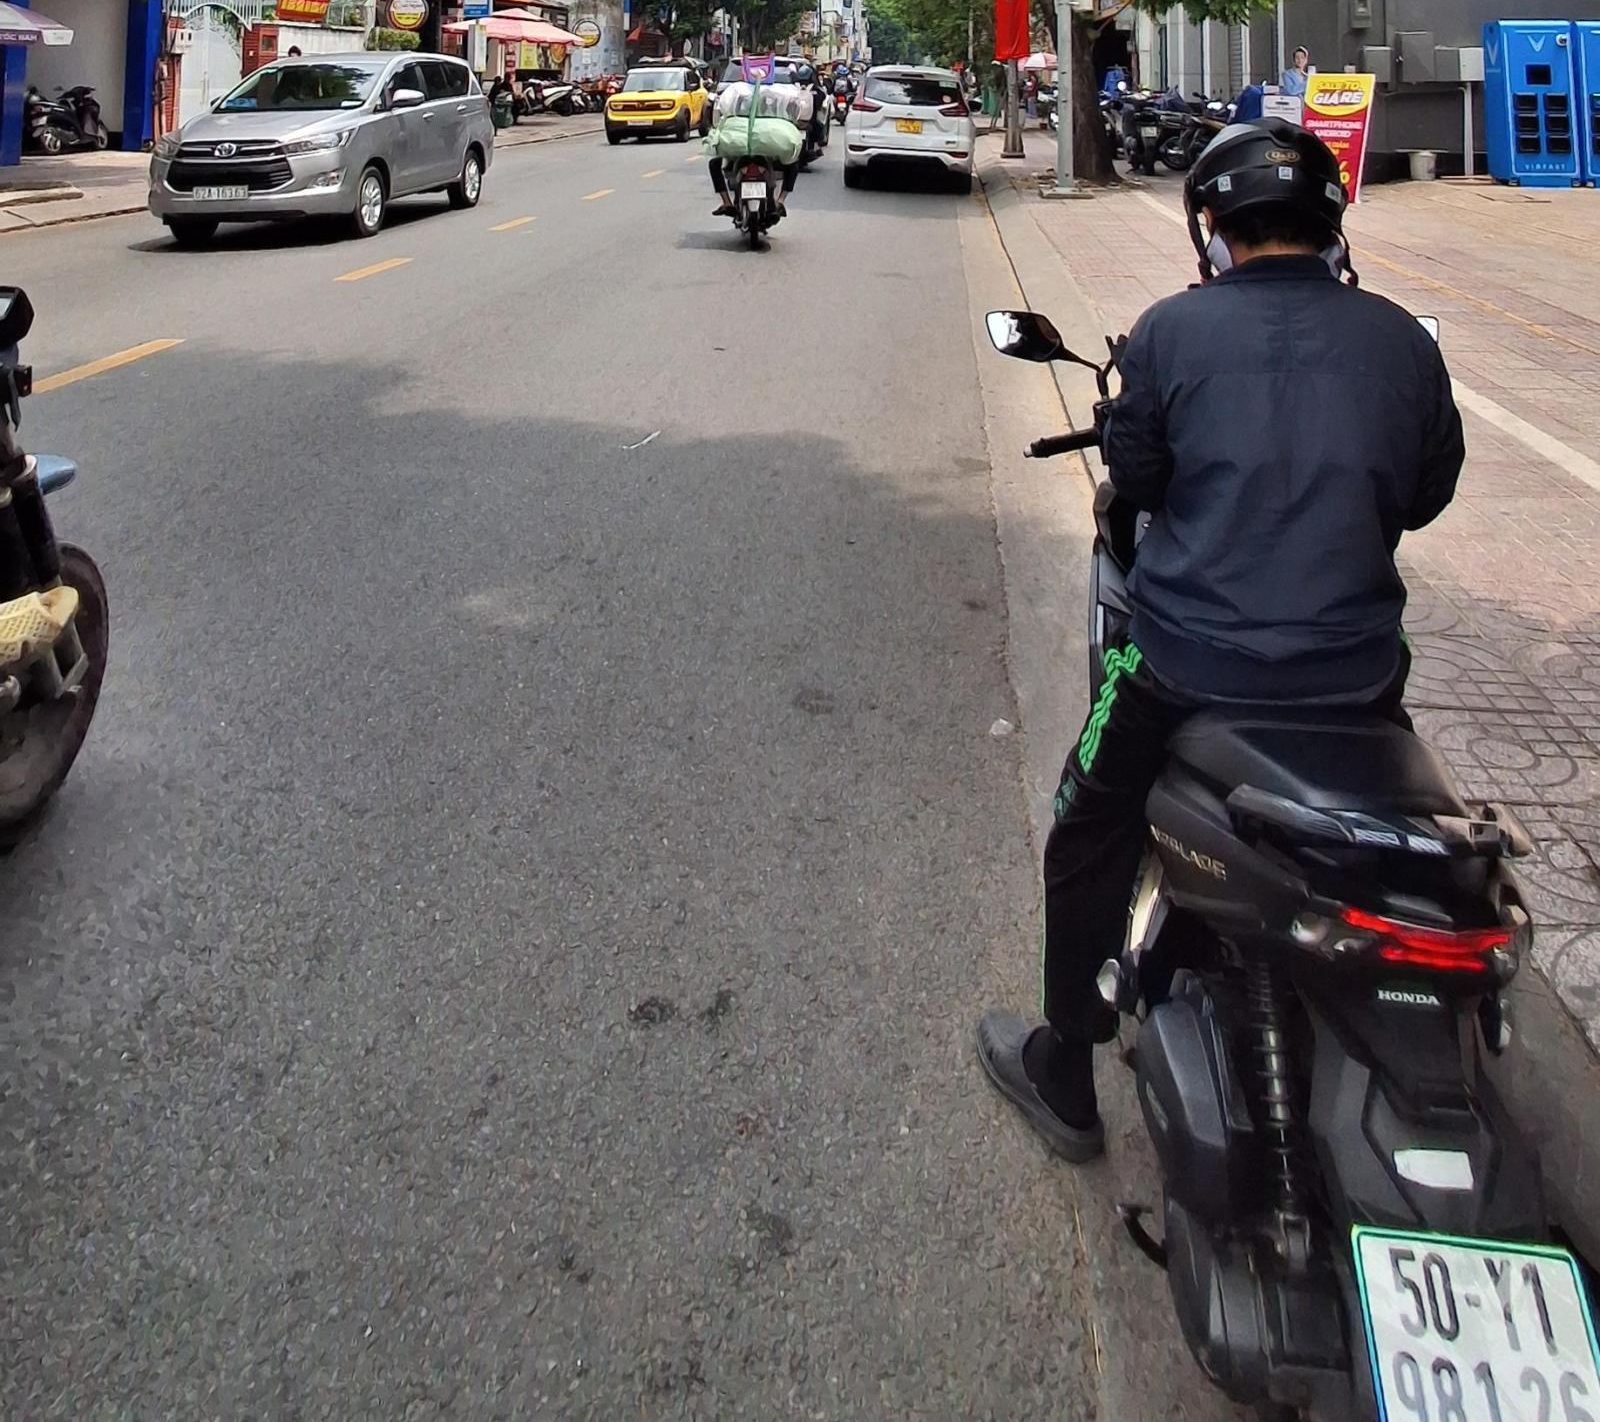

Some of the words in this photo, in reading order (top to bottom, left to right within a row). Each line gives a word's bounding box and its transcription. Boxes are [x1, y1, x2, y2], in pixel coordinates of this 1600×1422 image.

[1305, 120, 1363, 130] SMARTPHONE
[1377, 989, 1441, 1006] HONDA
[1388, 1247, 1559, 1356] 50-Y1
